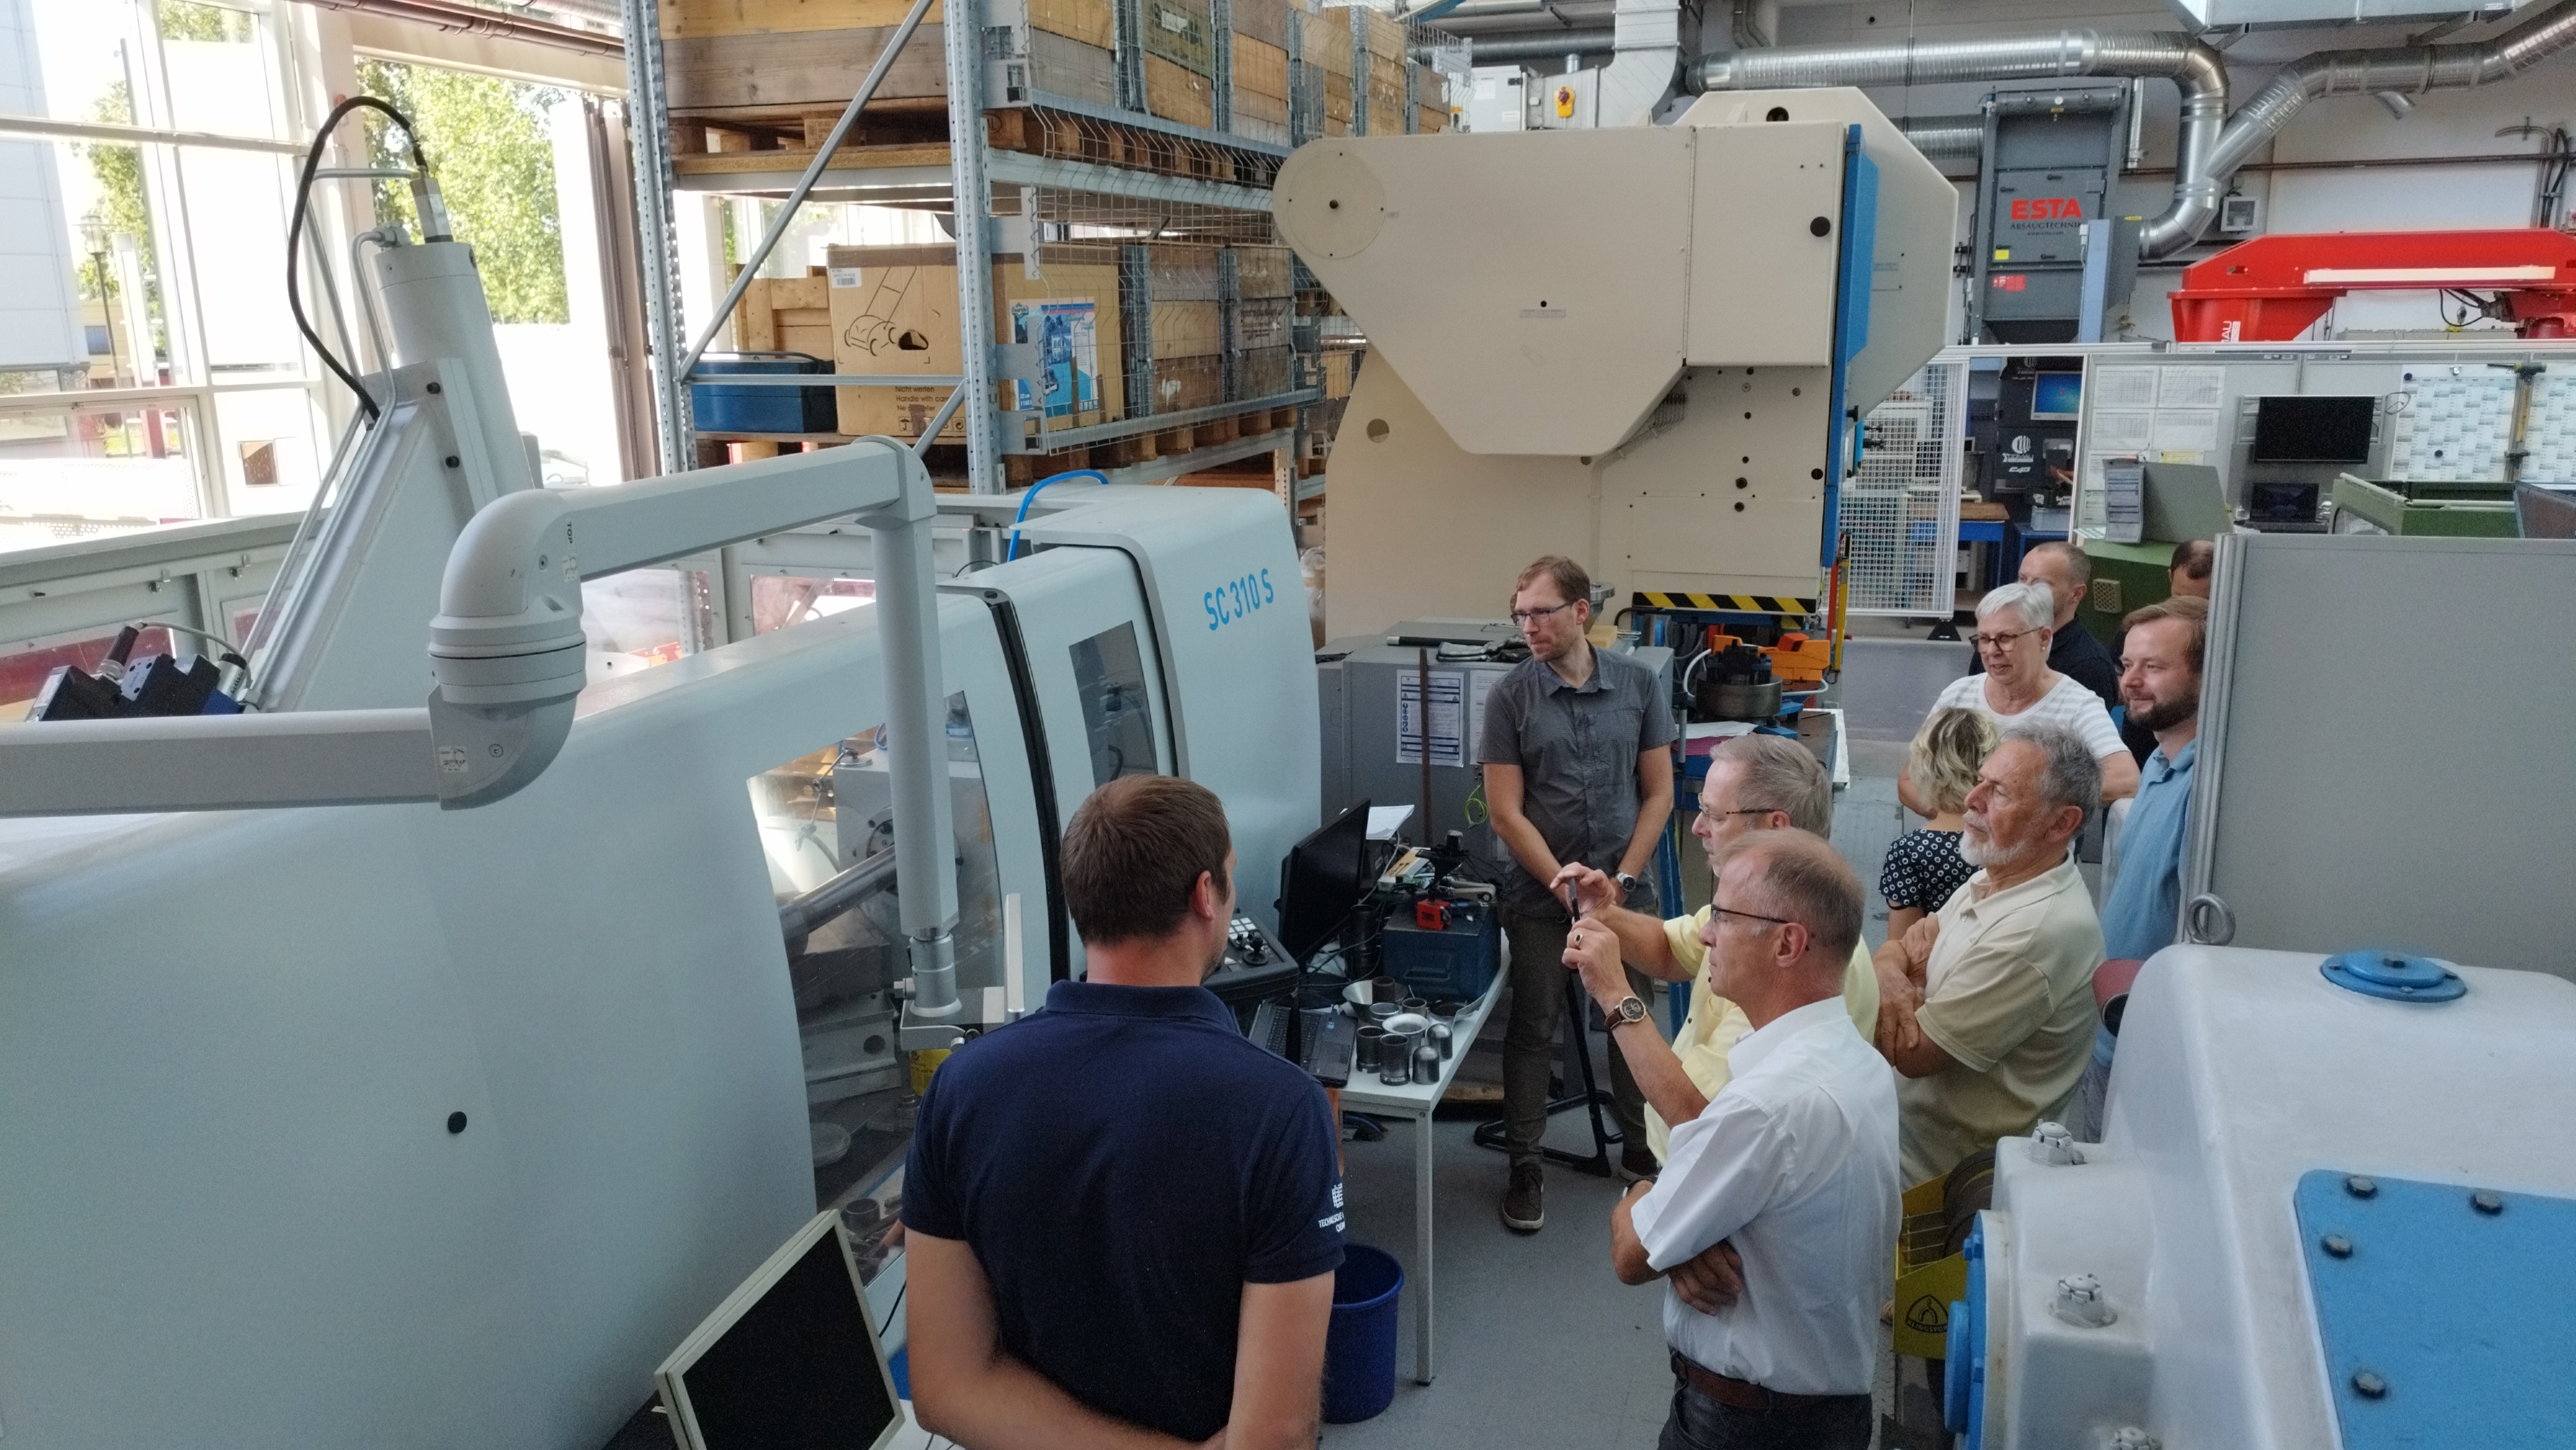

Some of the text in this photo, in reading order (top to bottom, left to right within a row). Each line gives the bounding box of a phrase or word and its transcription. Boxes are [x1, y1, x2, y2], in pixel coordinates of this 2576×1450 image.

[2011, 198, 2082, 220] ESTA
[2221, 320, 2232, 342] AU
[1204, 568, 1274, 631] SC 310 S
